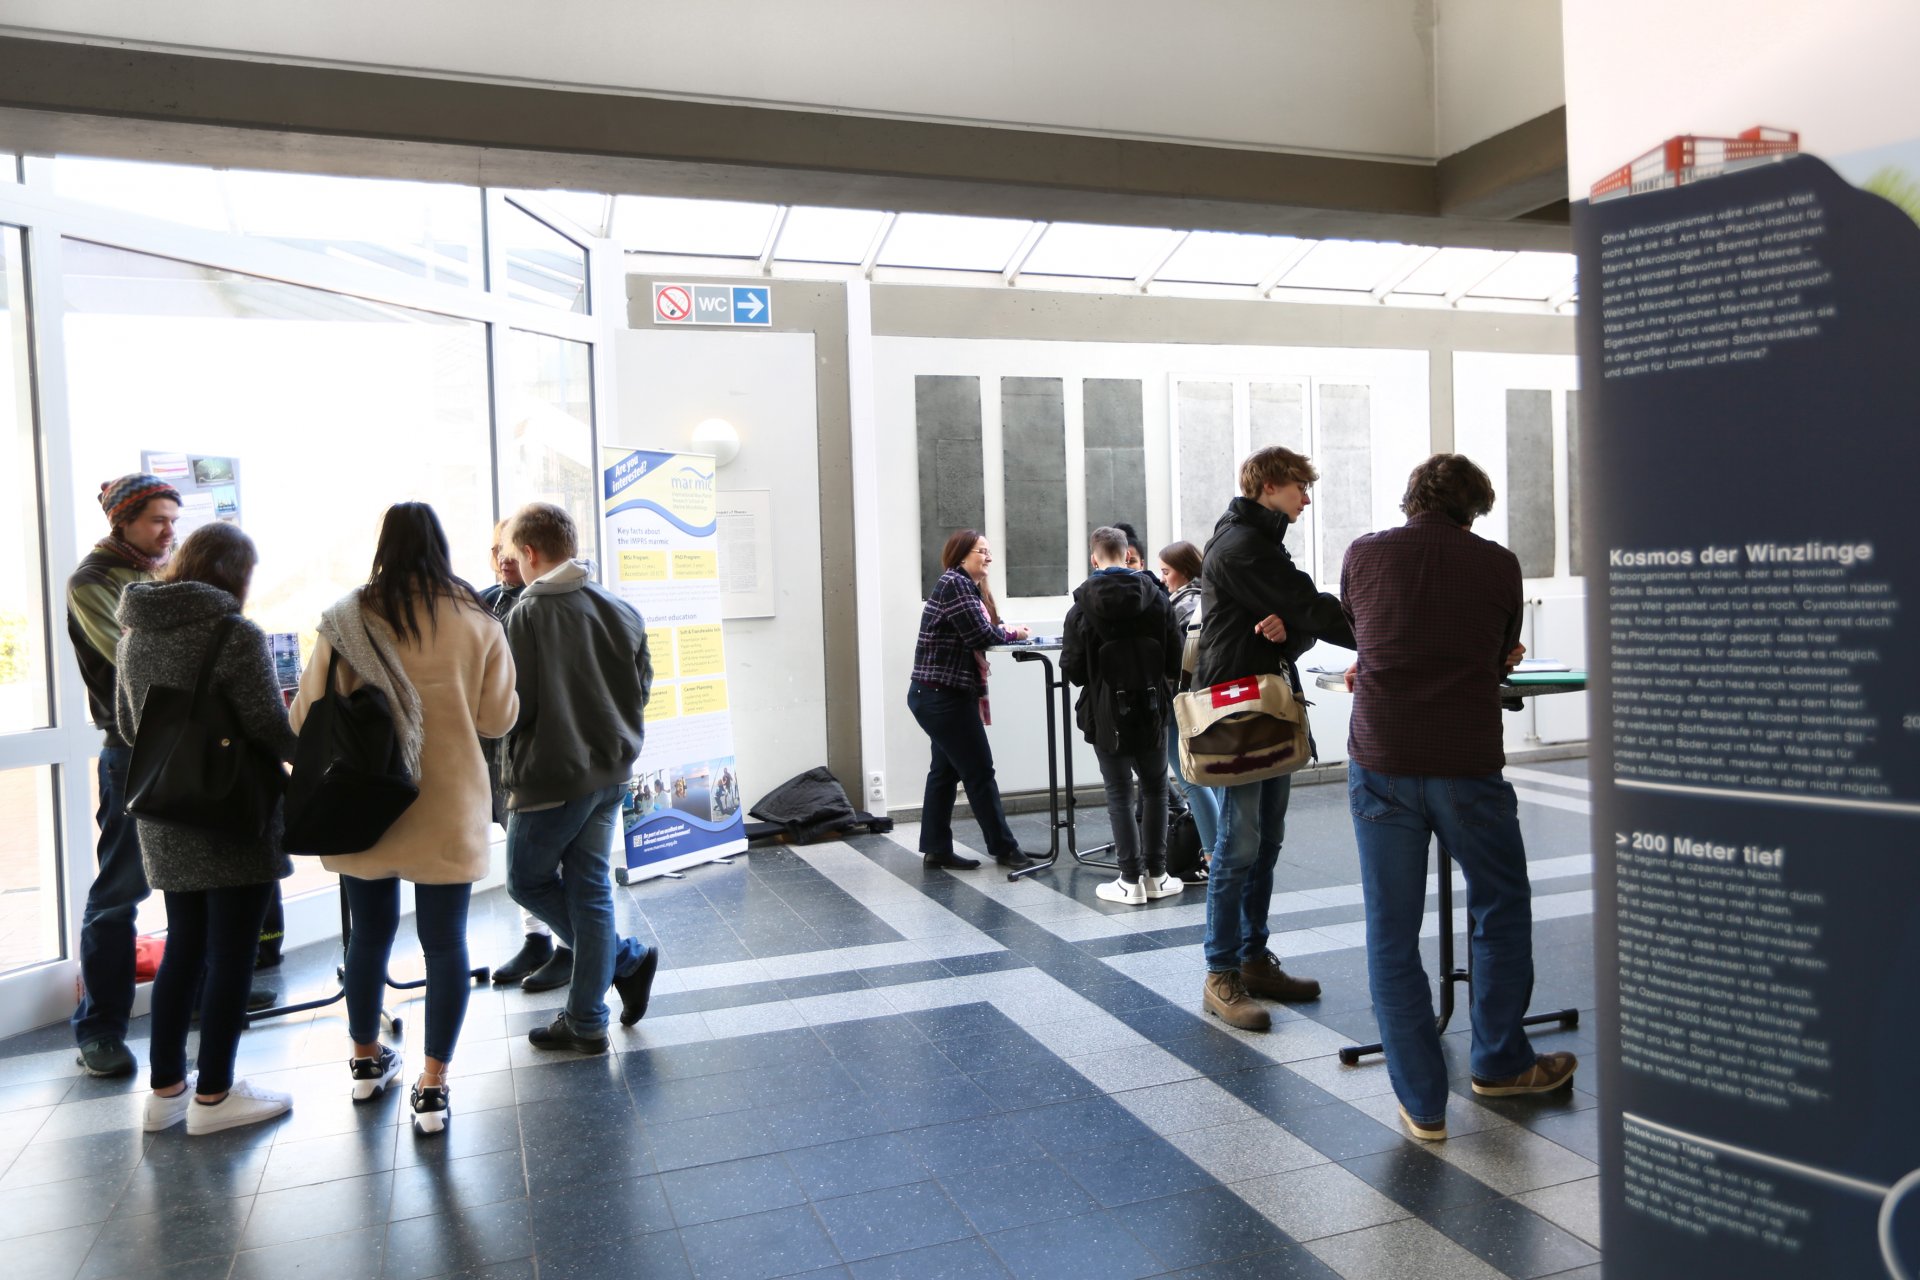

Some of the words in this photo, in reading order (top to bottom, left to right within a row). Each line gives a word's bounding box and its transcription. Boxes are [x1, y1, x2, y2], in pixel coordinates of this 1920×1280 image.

[699, 297, 727, 312] WC
[612, 460, 648, 493] interested?
[615, 463, 627, 478] Are
[627, 455, 639, 472] you
[630, 527, 643, 535] facts
[1610, 547, 1693, 567] Kosmos
[1700, 546, 1738, 564] der
[1745, 542, 1873, 565] Winzlinge
[646, 614, 667, 623] student
[668, 613, 698, 621] education
[1632, 832, 1668, 852] 200
[1673, 836, 1735, 861] Meter
[1744, 844, 1783, 867] tief
[1625, 1123, 1679, 1150] Unbekannte
[1681, 1143, 1713, 1160] Tiefen
